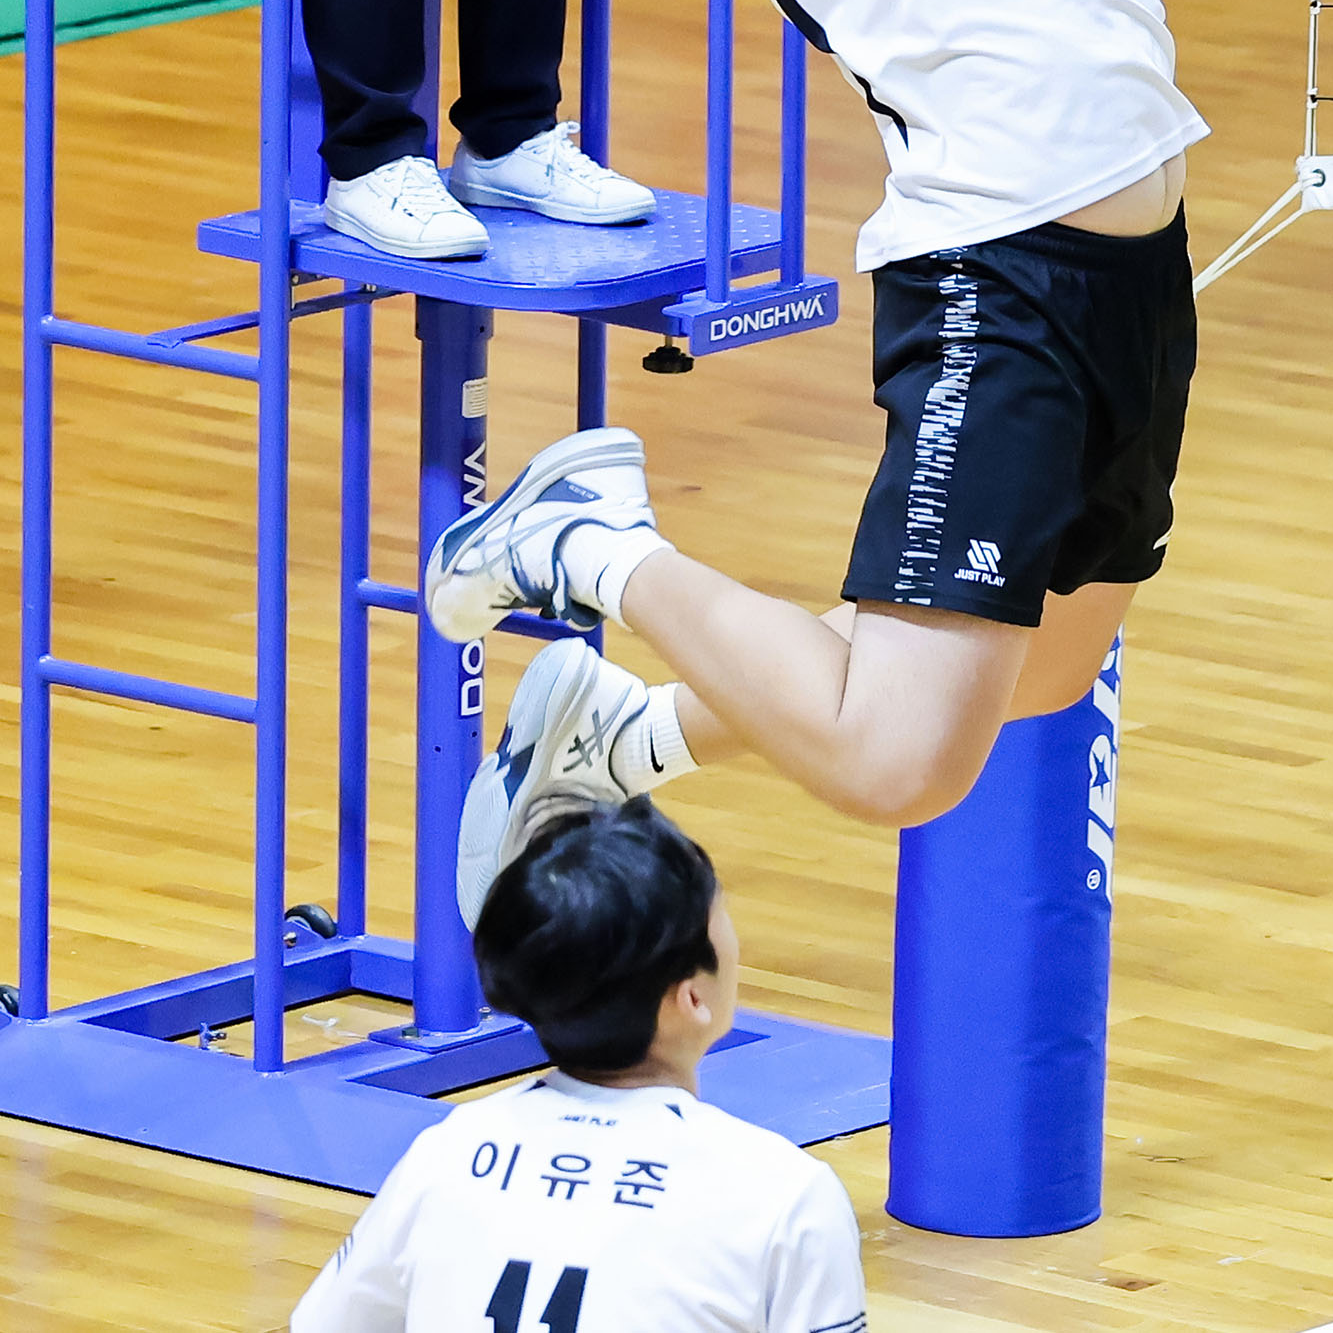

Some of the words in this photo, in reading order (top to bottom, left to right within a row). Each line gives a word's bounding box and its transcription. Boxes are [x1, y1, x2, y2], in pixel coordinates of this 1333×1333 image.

[709, 294, 824, 341] DONGHWA
[954, 568, 981, 582] JUST
[981, 572, 1006, 587] PLAY
[470, 1140, 669, 1210] 이유준
